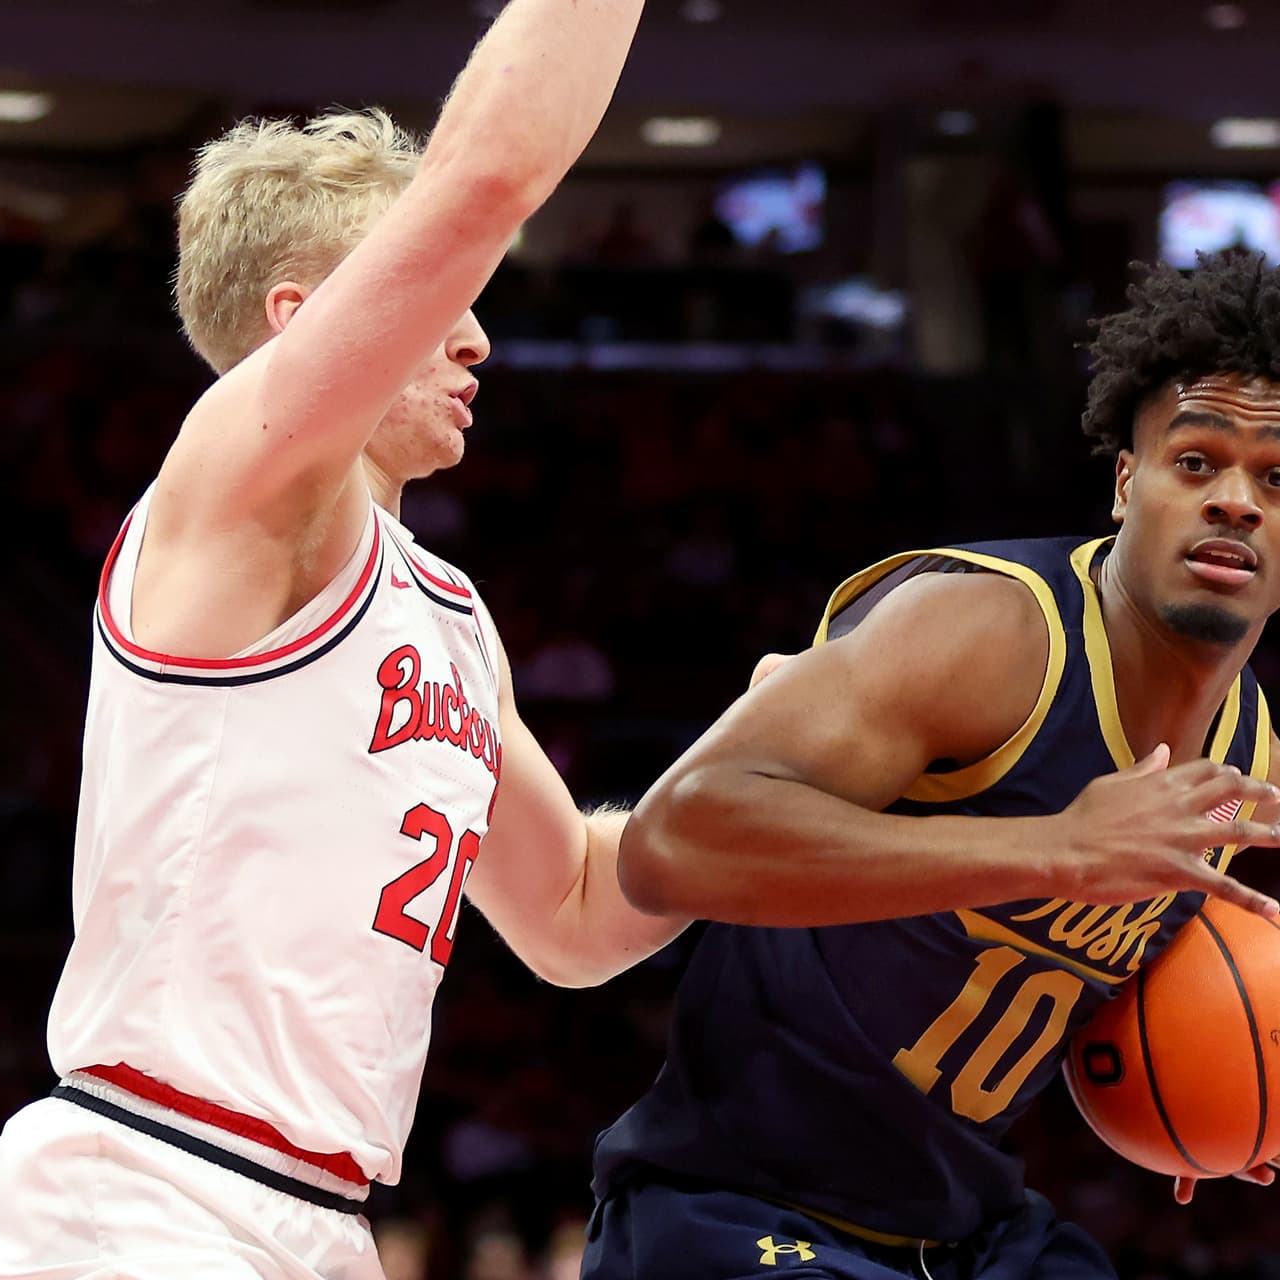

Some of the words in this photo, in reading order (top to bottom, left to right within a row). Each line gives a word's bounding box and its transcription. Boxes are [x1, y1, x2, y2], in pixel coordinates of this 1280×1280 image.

[368, 644, 502, 800] Buckey
[372, 802, 480, 967] 20
[892, 945, 1085, 1124] 10
